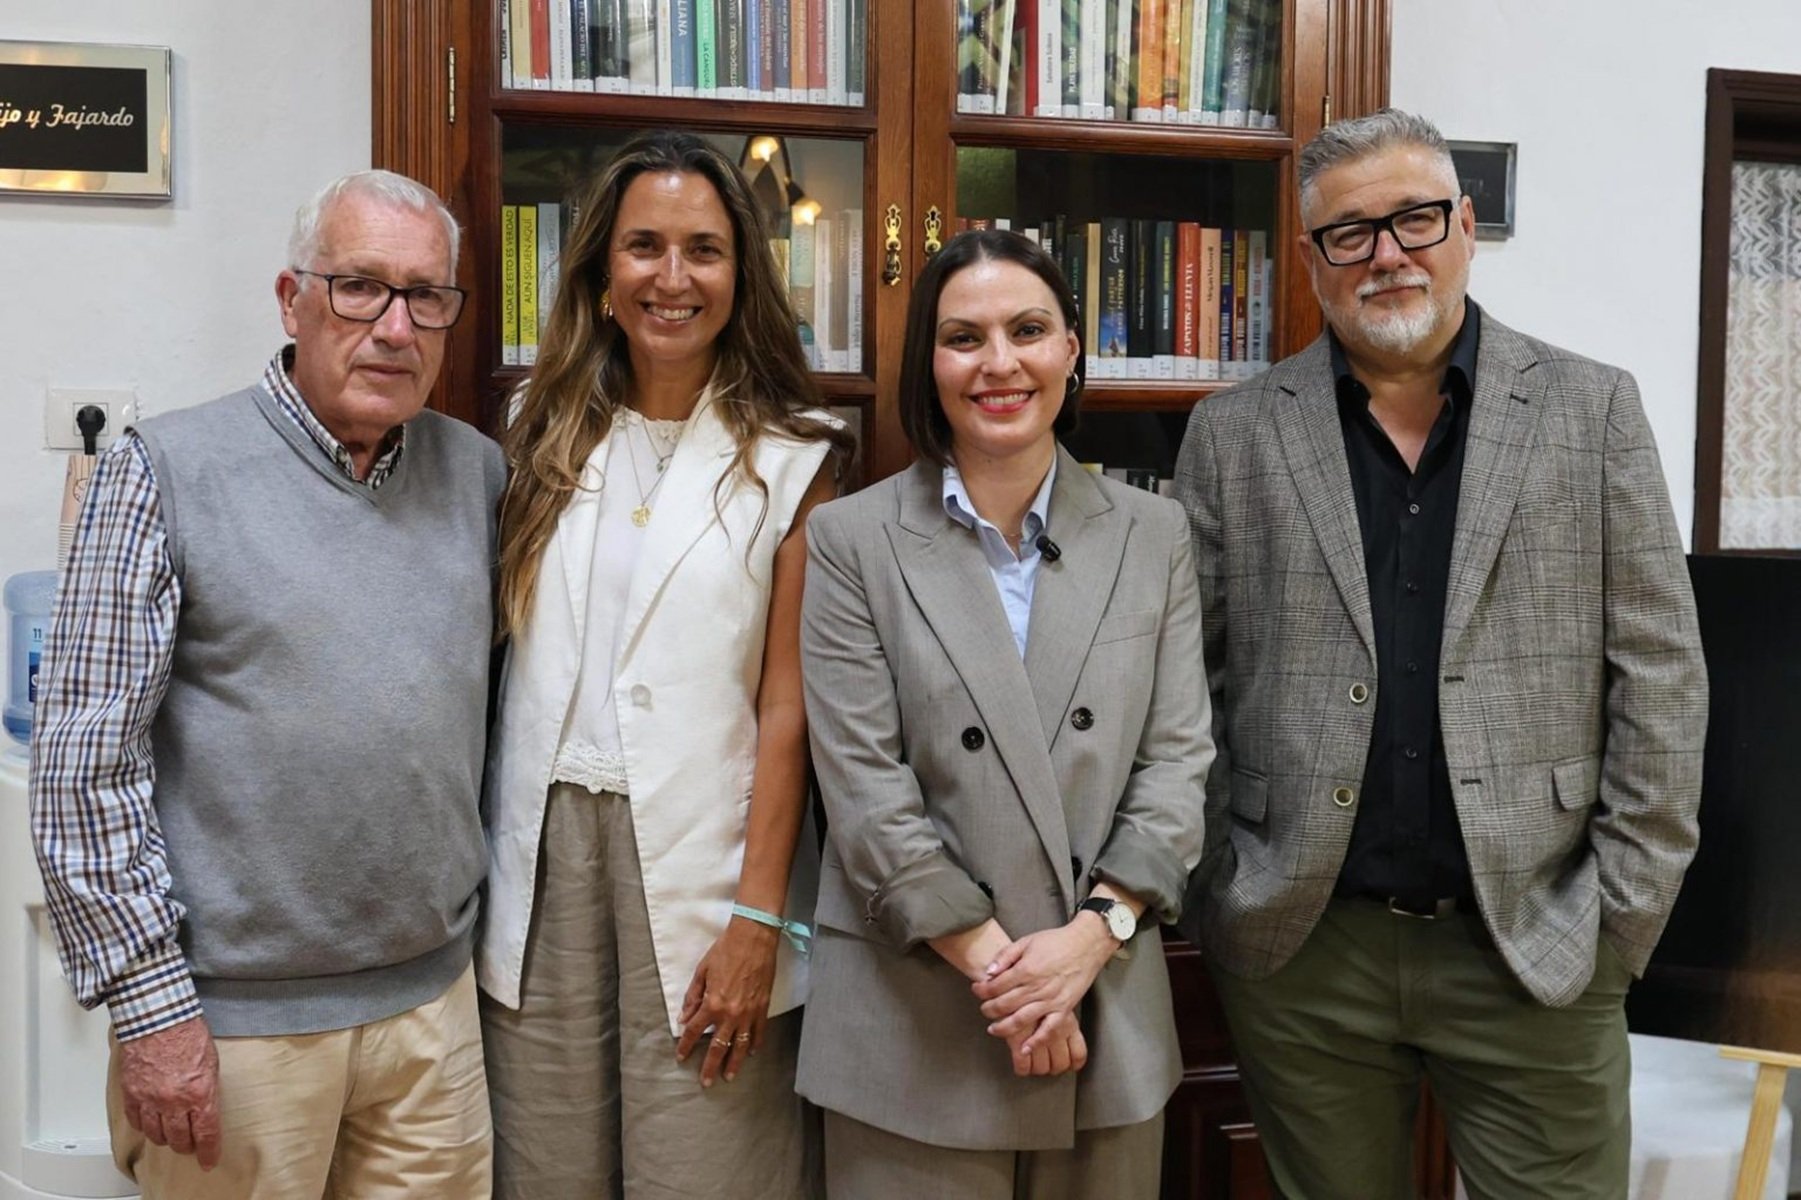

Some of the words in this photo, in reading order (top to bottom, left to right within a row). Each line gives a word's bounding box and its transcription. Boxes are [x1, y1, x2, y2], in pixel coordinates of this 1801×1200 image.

[1068, 47, 1077, 73] SOLEDAD
[25, 110, 41, 129] y
[45, 103, 134, 130] Fajardo
[505, 209, 515, 246] VERDAD
[521, 218, 533, 244] AQUÍ
[505, 248, 515, 258] ES
[522, 245, 534, 280] SIGUEN
[505, 260, 515, 282] ESTO
[505, 283, 515, 296] DE
[1117, 269, 1125, 309] PATTERSON
[505, 297, 515, 325] NADA
